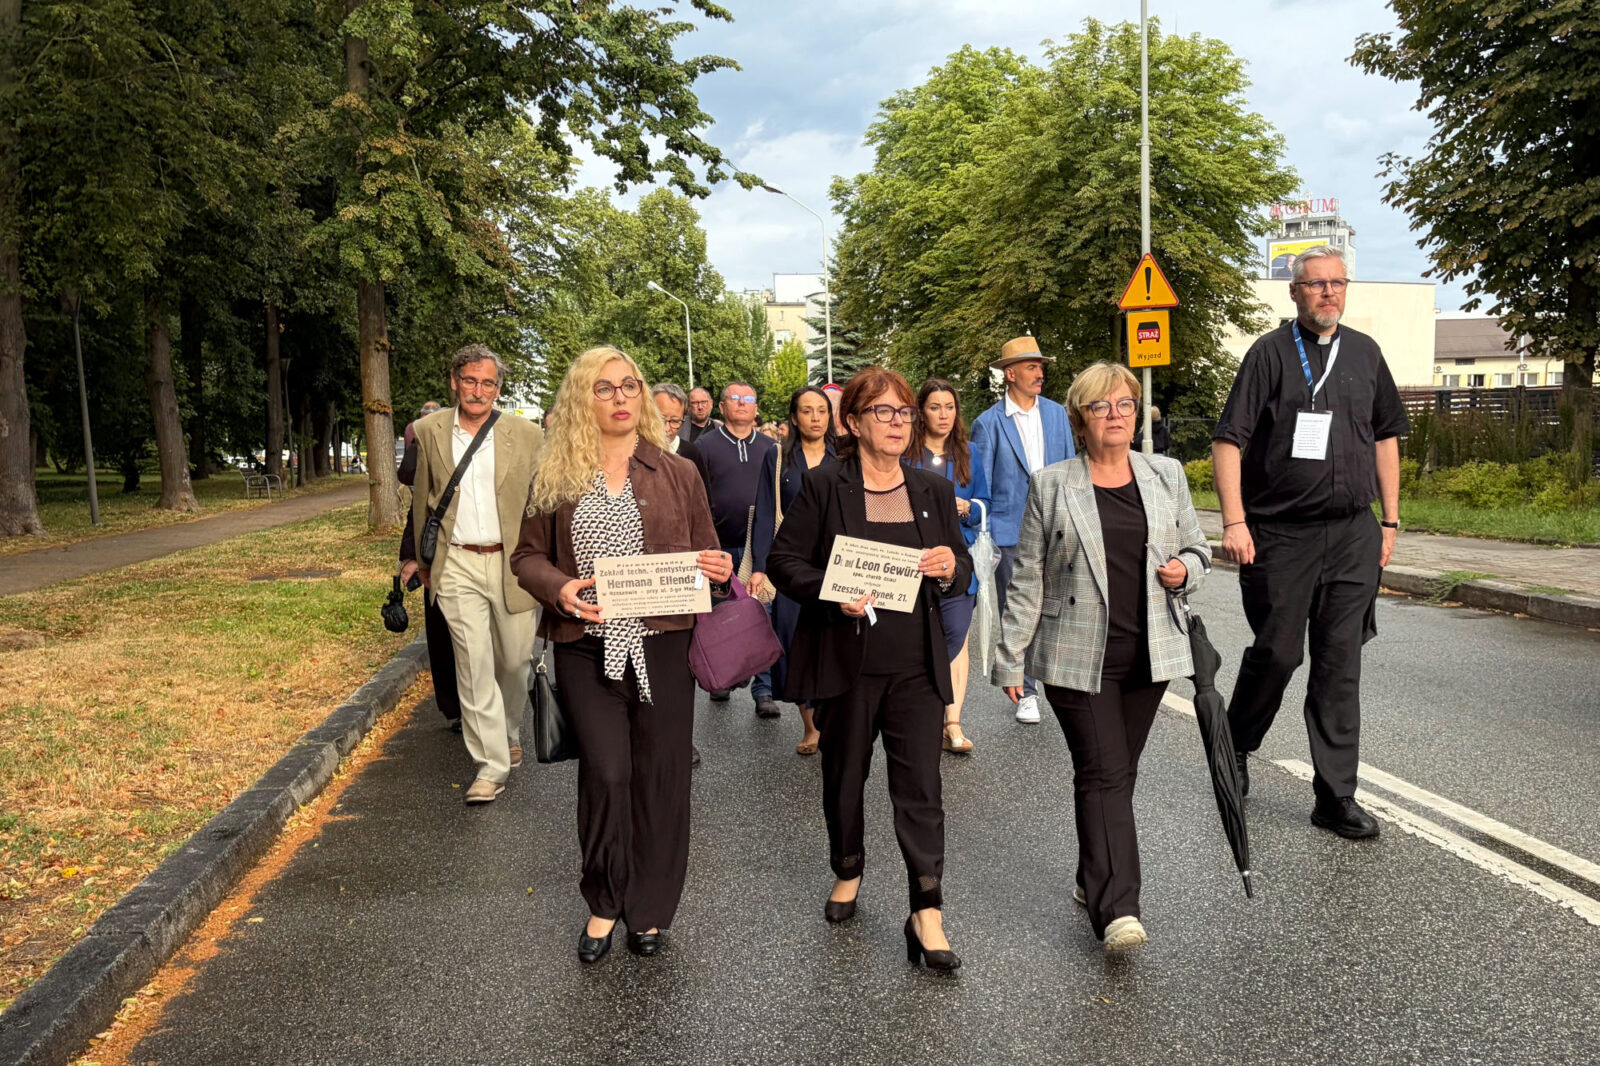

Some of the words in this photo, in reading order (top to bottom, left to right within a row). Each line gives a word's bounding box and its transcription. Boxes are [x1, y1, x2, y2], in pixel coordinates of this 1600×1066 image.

[1138, 330, 1159, 339] STRAŻ
[1137, 352, 1161, 360] Wyjazd
[655, 565, 698, 574] dentystyczn
[855, 557, 880, 572] Leon
[883, 562, 920, 579] Gewürz
[607, 578, 653, 589] Hermana
[660, 575, 696, 585] Ellenda
[870, 588, 895, 600] Rynek
